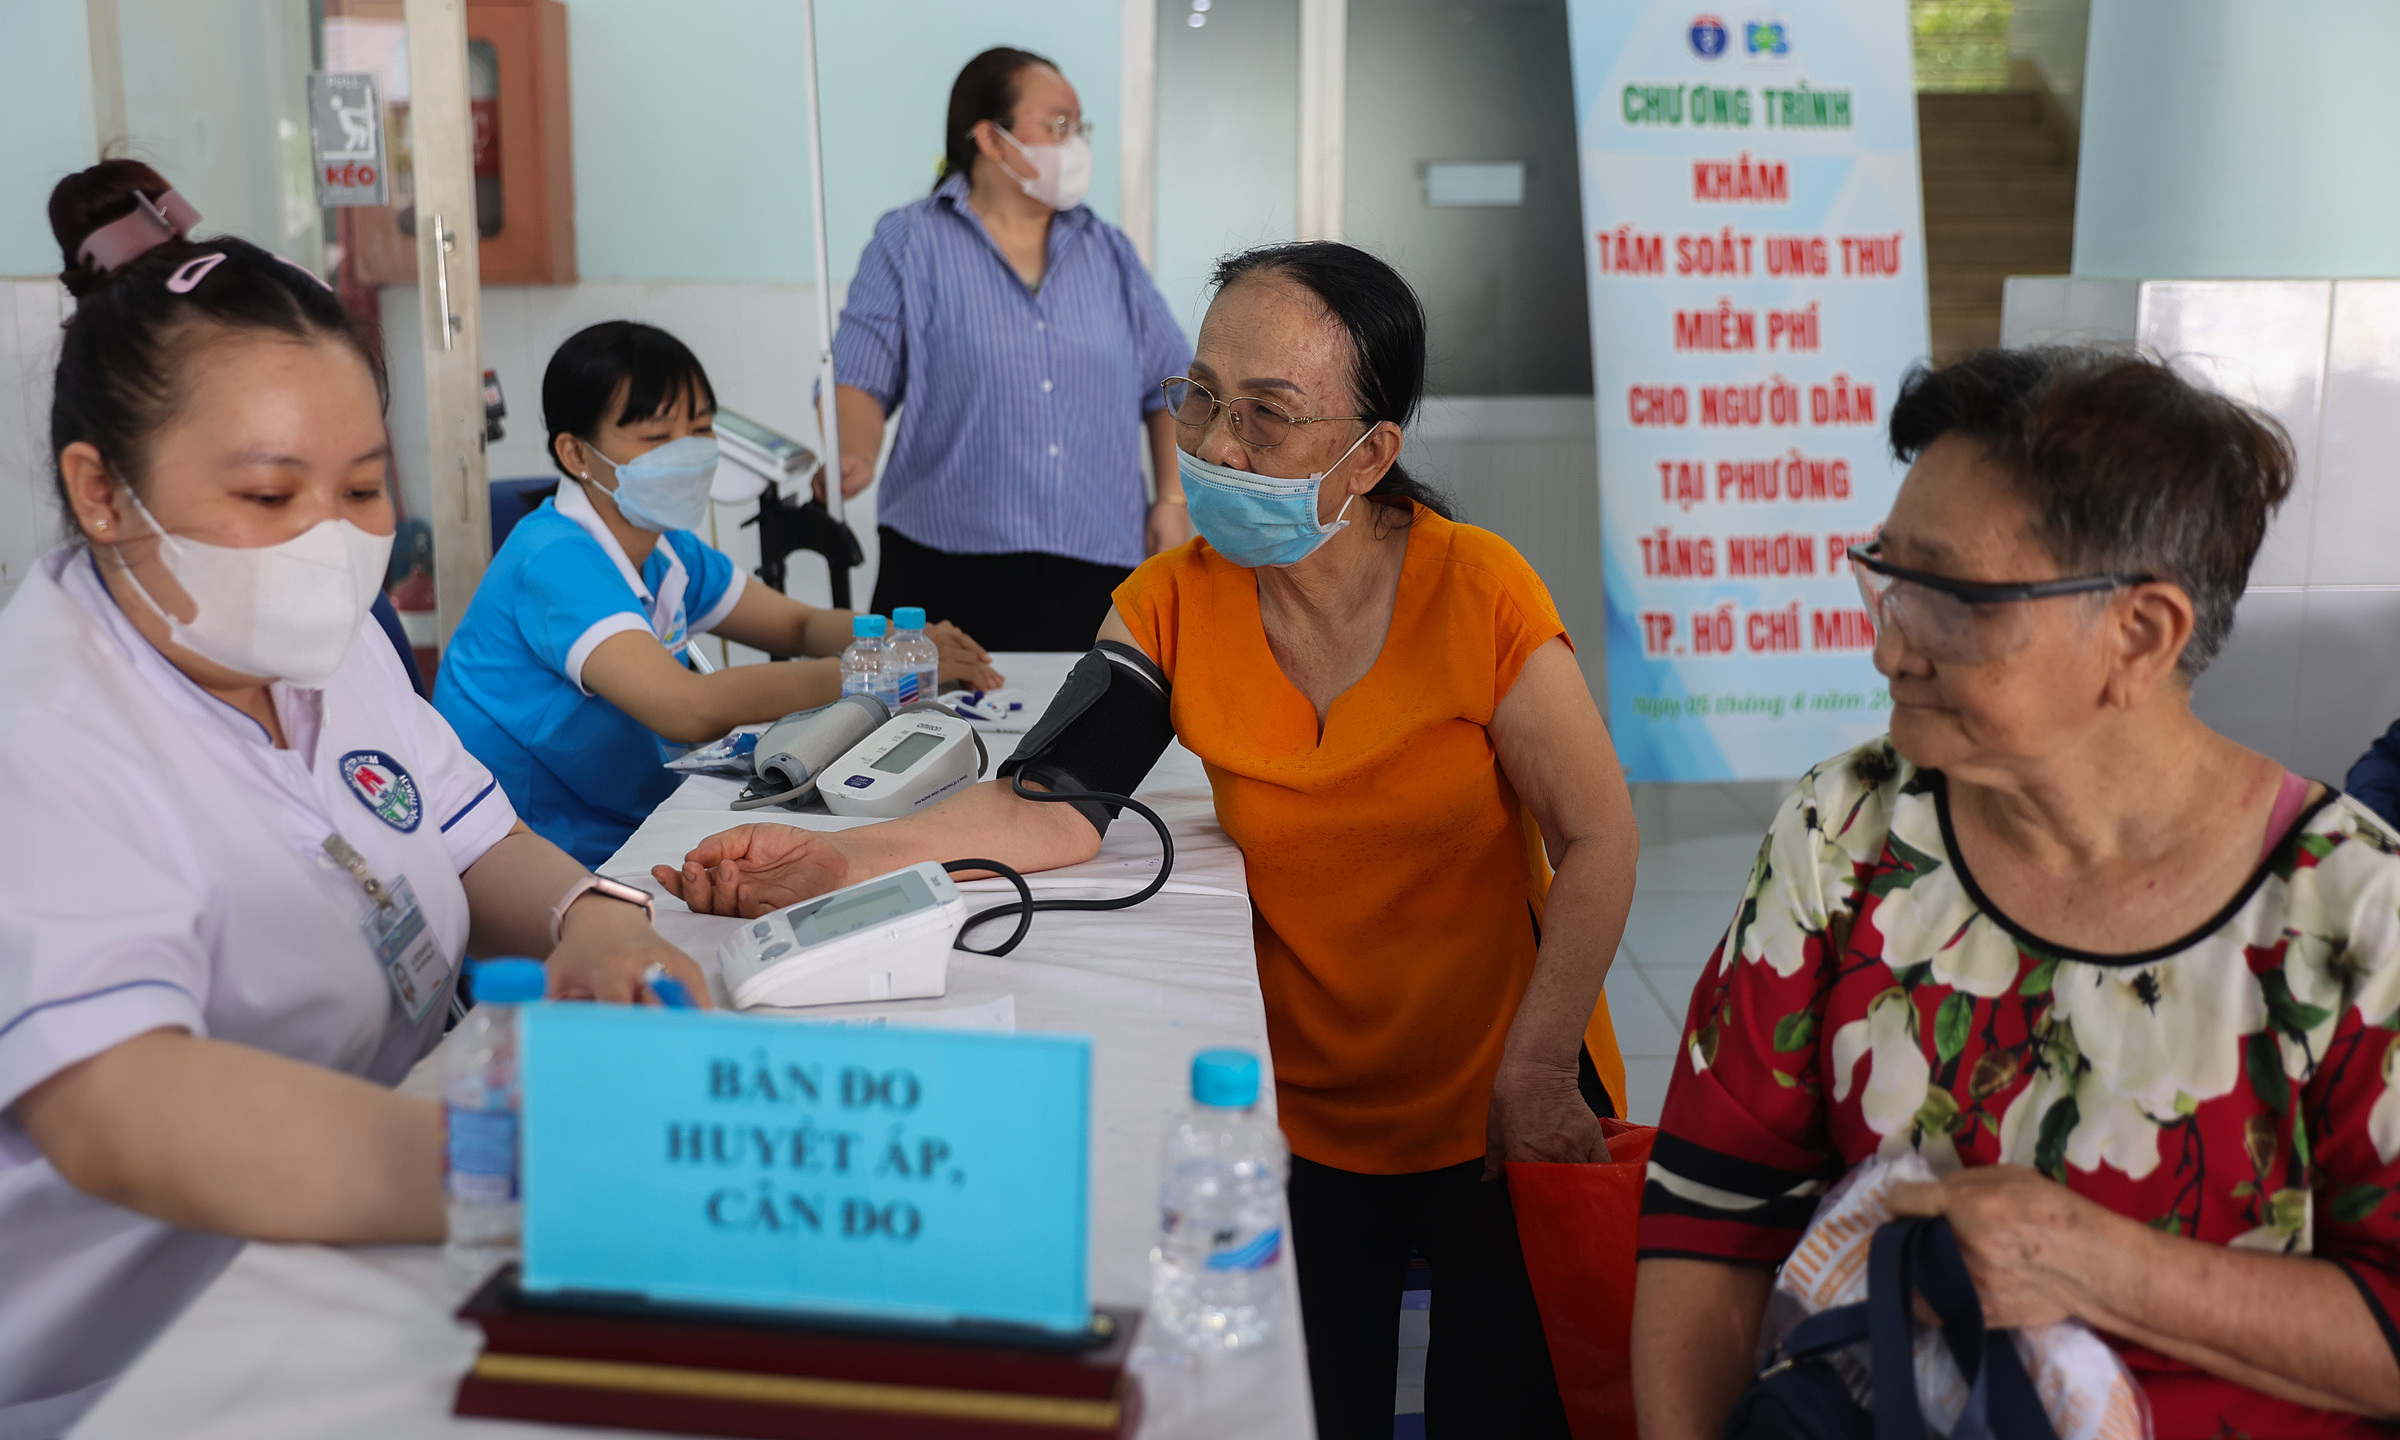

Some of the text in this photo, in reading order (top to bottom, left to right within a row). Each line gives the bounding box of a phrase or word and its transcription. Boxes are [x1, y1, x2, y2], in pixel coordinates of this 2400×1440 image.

[1622, 79, 1853, 128] CHƯƠNG TRÌNH
[326, 160, 376, 187] KÉO
[1693, 151, 1788, 202] KHÁM
[1675, 225, 1755, 277] SOÁT
[1765, 237, 1828, 278] UNG
[1839, 230, 1903, 277] THƯ
[1674, 296, 1820, 351] MIỄN PHÍ
[1628, 373, 1876, 428] CHO NGƯỜI DÂN
[1658, 448, 1852, 512] TẠI PHƯỜNG
[1639, 526, 1715, 577] TĂNG
[1728, 532, 1815, 577] NHƠN
[1640, 600, 1877, 655] TP. HỒ CHÍ MIN
[1810, 688, 1863, 711] năm
[704, 1177, 824, 1234] CÂN
